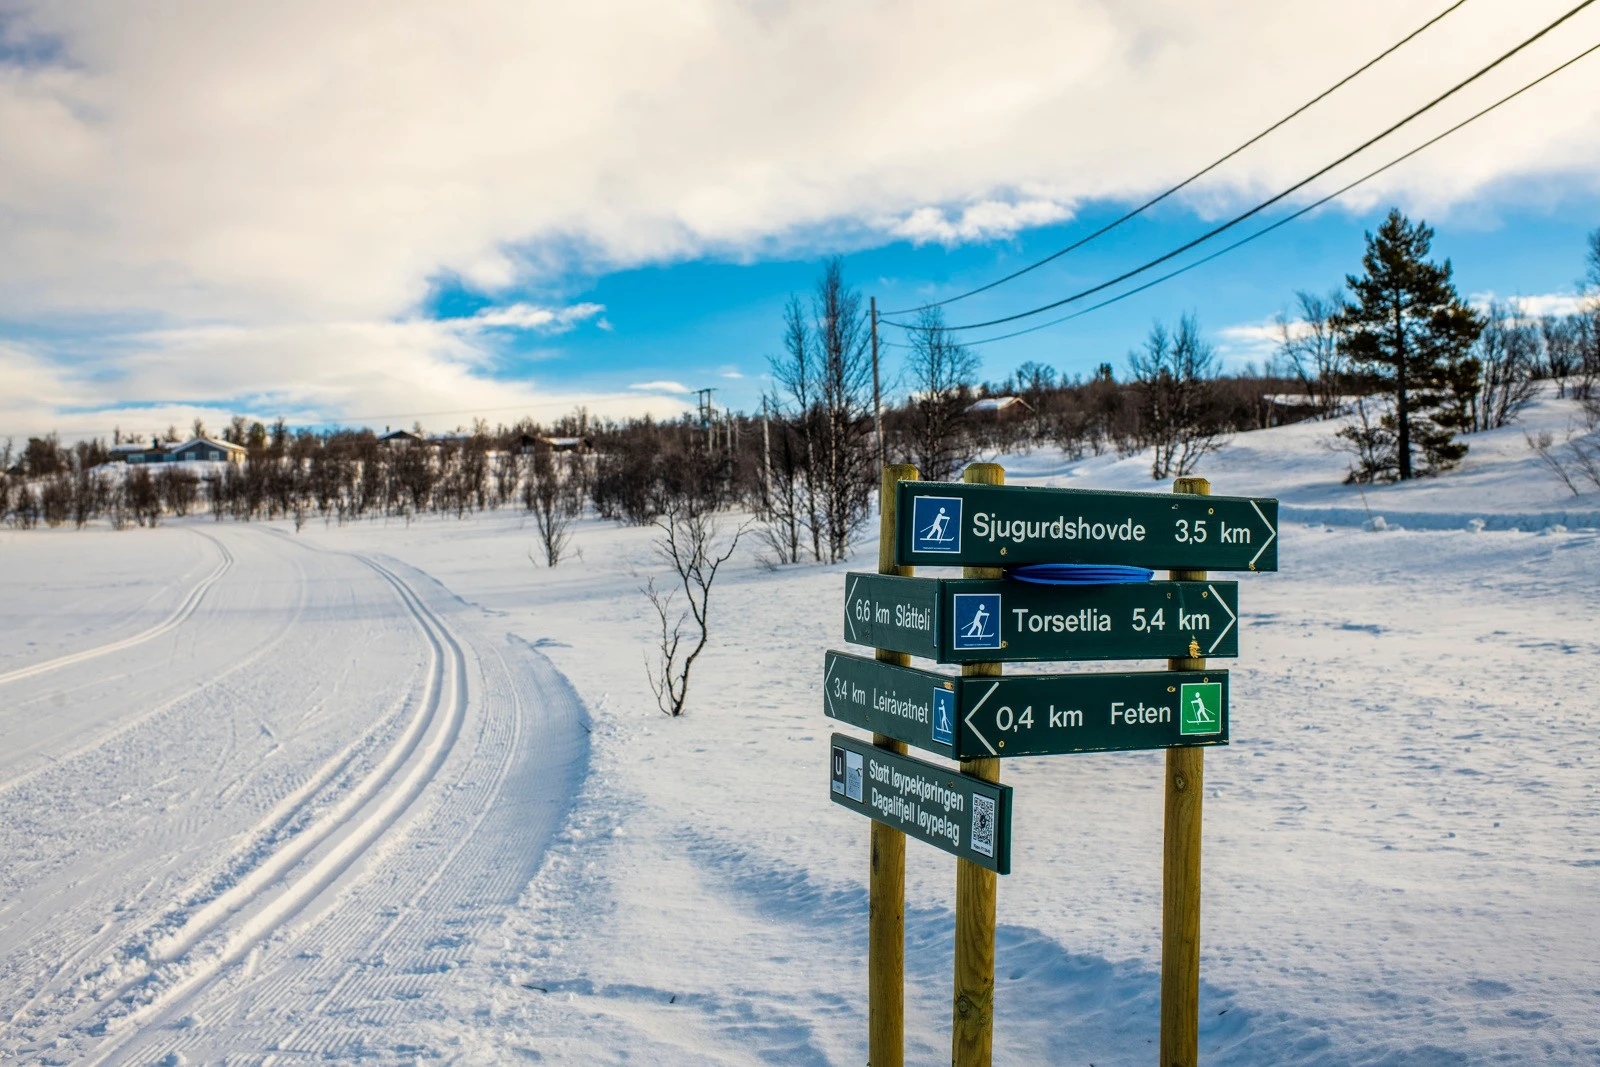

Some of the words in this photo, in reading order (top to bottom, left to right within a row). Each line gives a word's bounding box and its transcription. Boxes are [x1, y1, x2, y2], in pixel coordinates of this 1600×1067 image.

[973, 513, 1146, 543] Sjugurdshovde
[1174, 519, 1207, 545] 3,5
[1220, 522, 1251, 543] km
[855, 598, 871, 623] 6,6
[875, 602, 890, 625] km
[895, 603, 931, 631] Slåtteli
[1012, 608, 1111, 632] Torsetlia
[1132, 608, 1165, 634] 5,4
[1179, 607, 1210, 630] km
[834, 677, 847, 701] 3,4
[852, 682, 866, 705] km
[873, 687, 929, 724] Leiråvatnet
[996, 705, 1034, 733] 0,4
[1049, 705, 1083, 727] km
[1111, 702, 1171, 725] Feten
[869, 759, 889, 781] Støtt
[891, 769, 964, 812] løypekjøringen
[871, 787, 915, 824] Dagalifjell
[917, 804, 960, 847] løypelag
